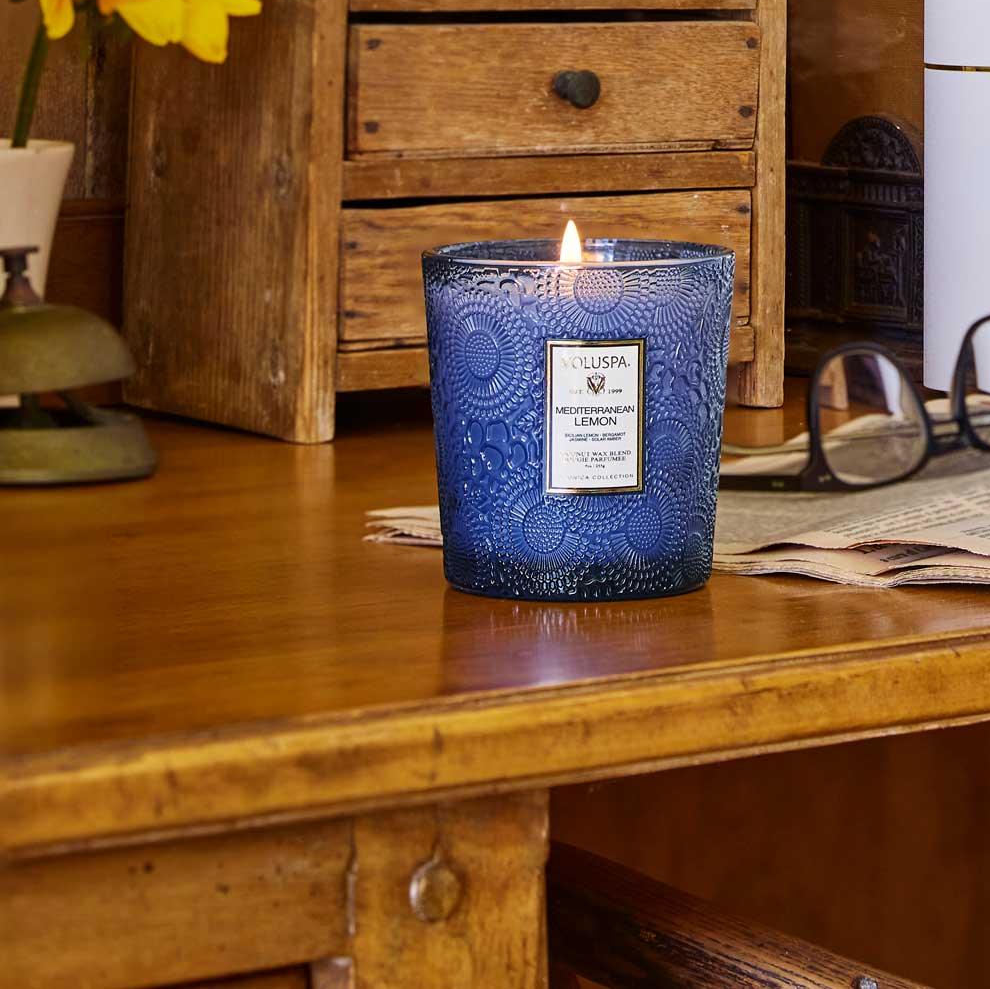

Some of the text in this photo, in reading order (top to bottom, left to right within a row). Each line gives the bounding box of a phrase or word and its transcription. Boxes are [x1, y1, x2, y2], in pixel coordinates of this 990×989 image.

[561, 354, 628, 370] VOLUSPA
[555, 404, 635, 415] MEDITERRANEAN
[574, 416, 617, 427] LEMON
